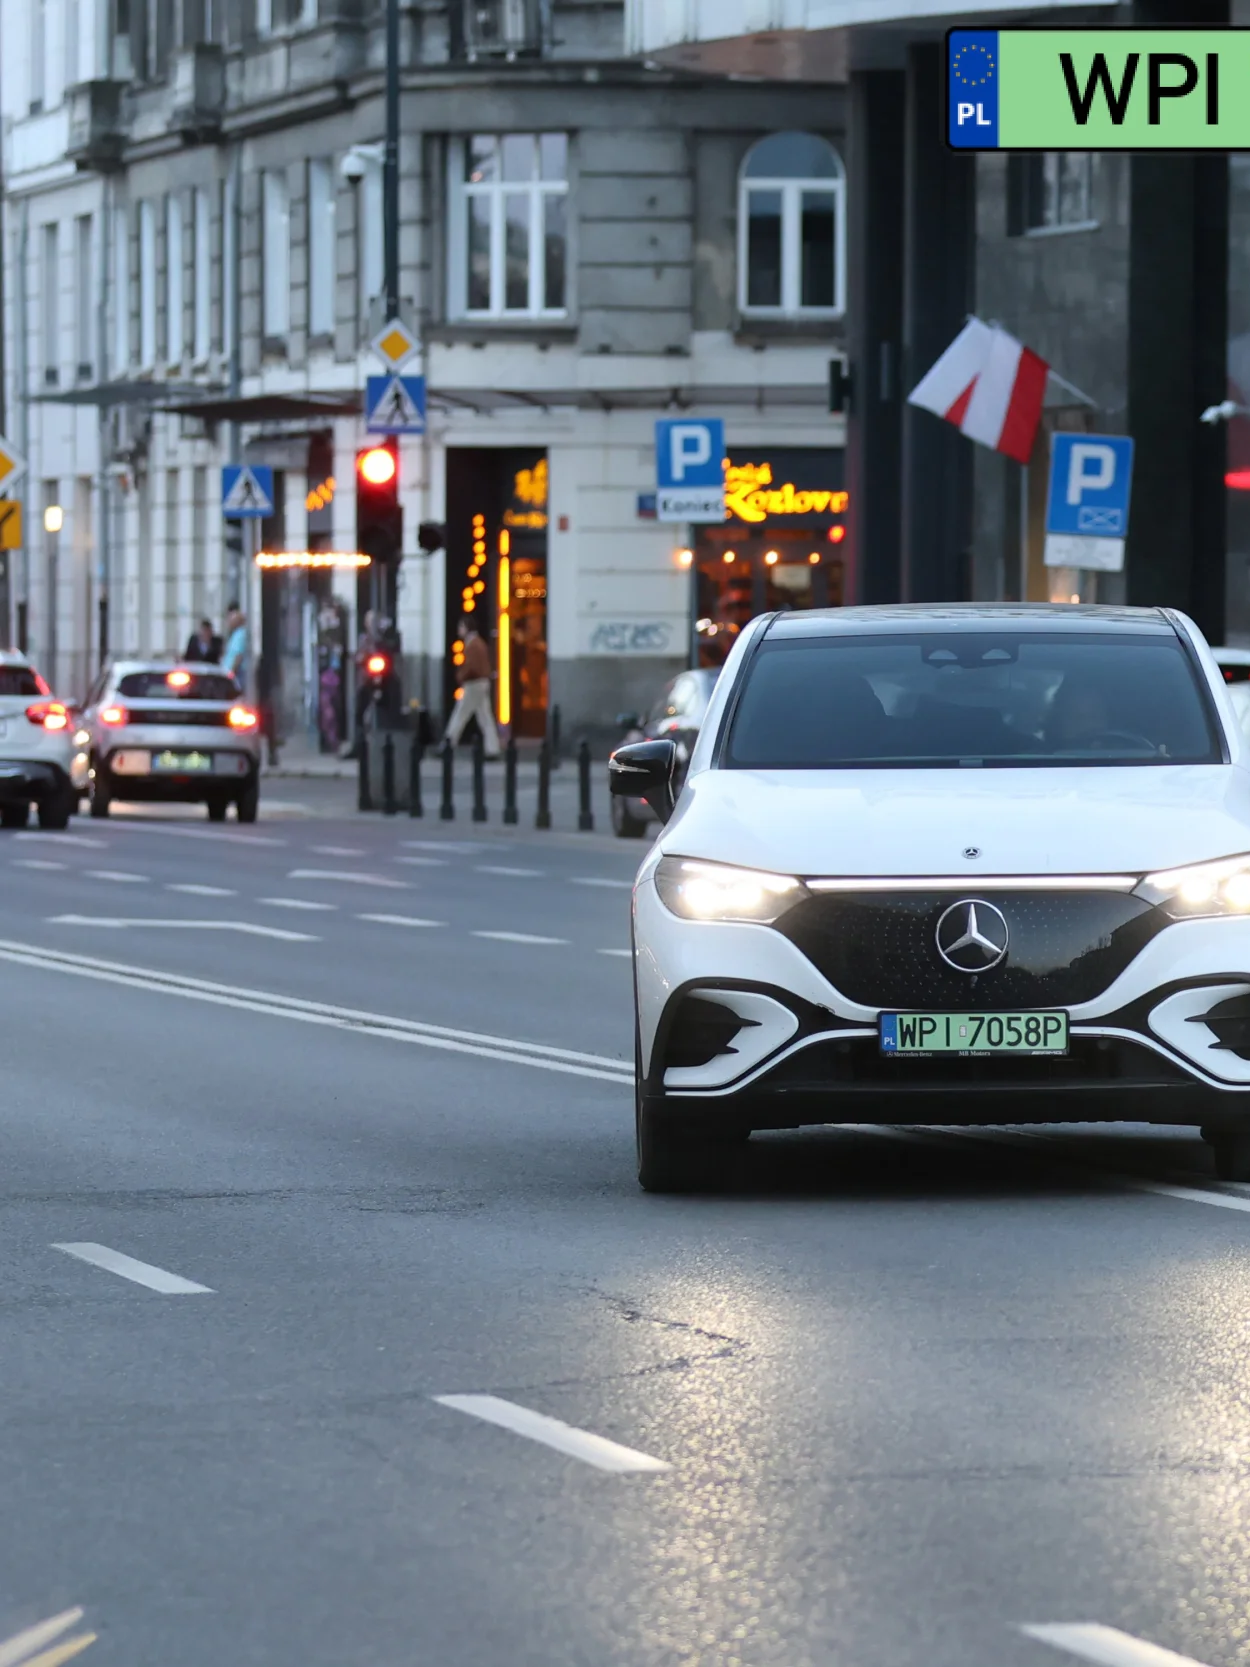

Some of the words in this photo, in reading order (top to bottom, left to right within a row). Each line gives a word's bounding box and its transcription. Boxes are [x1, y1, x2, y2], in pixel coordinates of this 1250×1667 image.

[670, 424, 712, 482] P
[1066, 443, 1116, 505] P
[884, 1037, 896, 1046] PL
[899, 1017, 951, 1047] WPI
[968, 1016, 1062, 1047] 7058P
